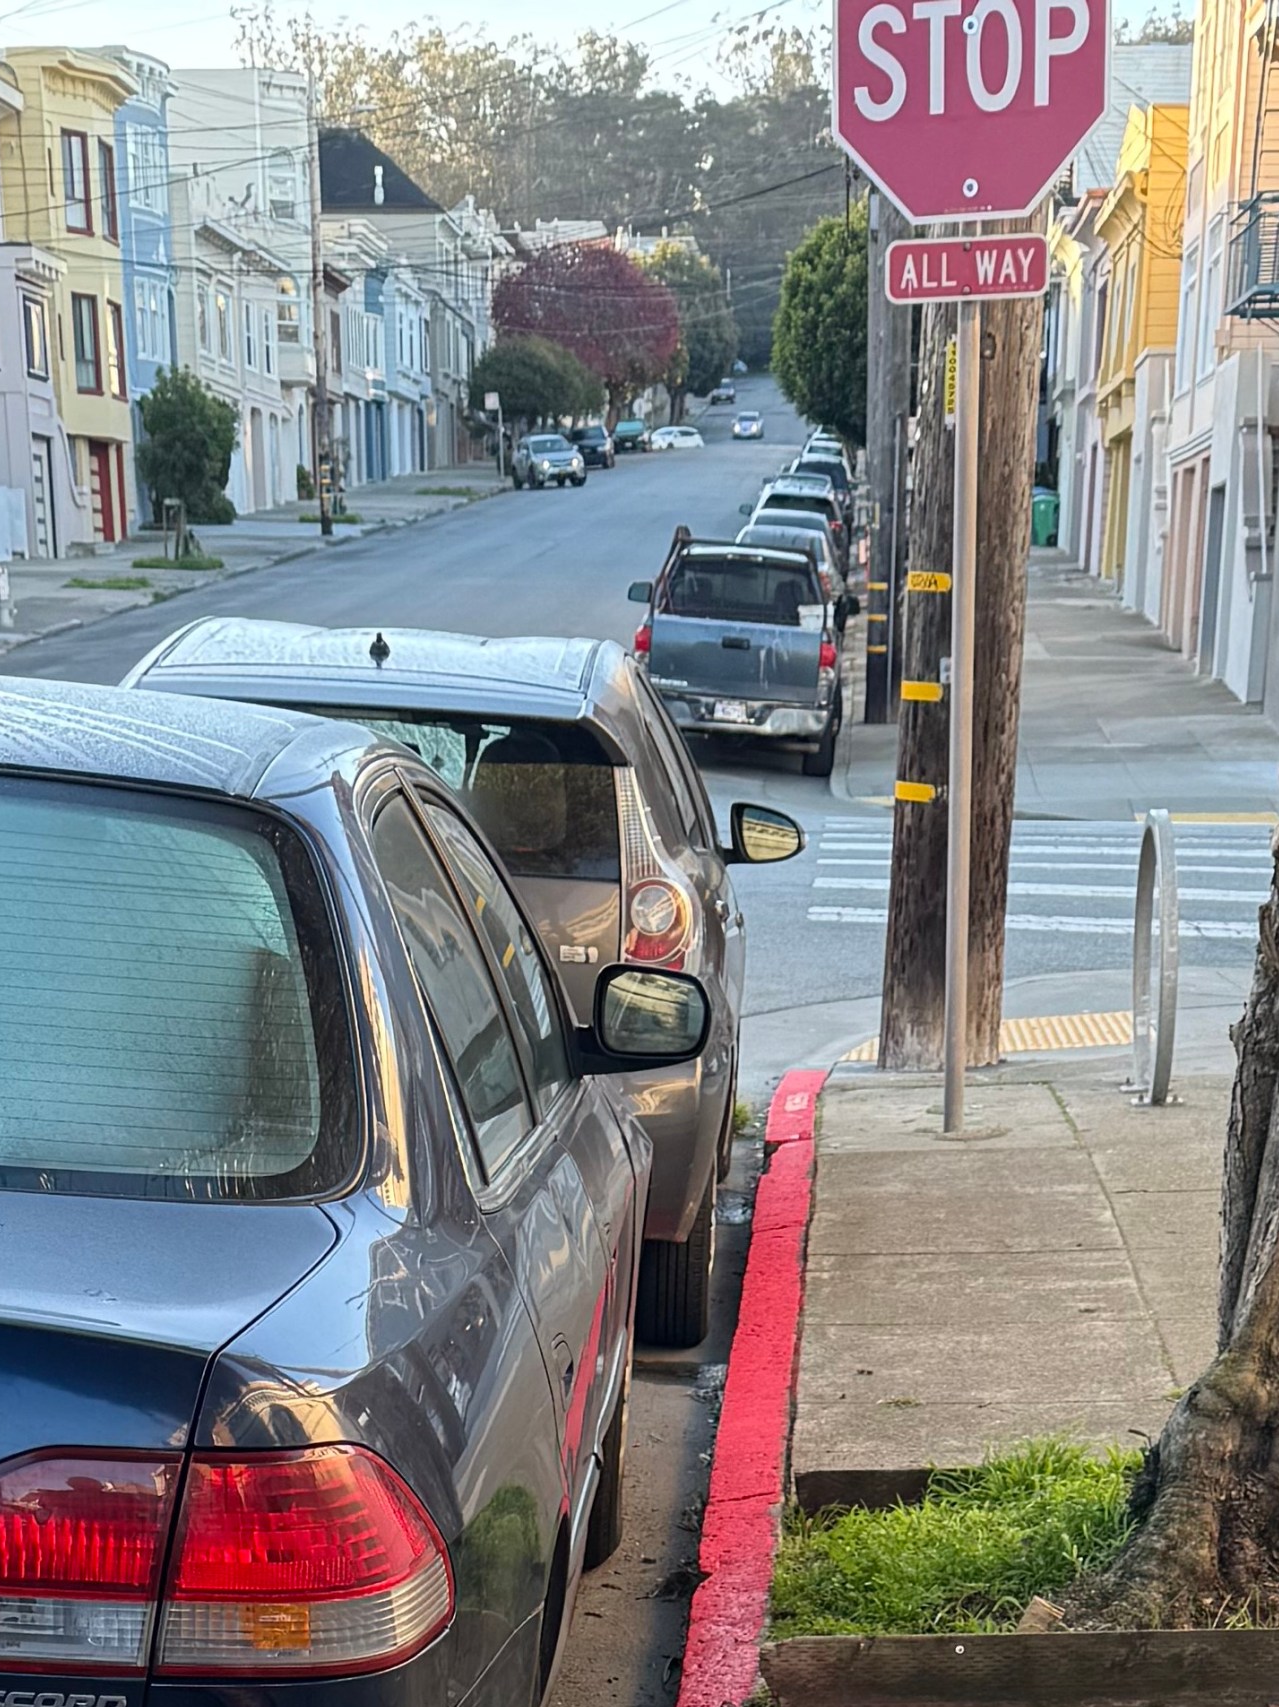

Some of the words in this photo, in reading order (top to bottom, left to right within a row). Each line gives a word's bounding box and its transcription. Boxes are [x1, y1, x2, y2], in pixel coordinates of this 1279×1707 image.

[853, 0, 1090, 122] STOP
[900, 252, 957, 292] ALL
[975, 247, 1036, 286] WAY
